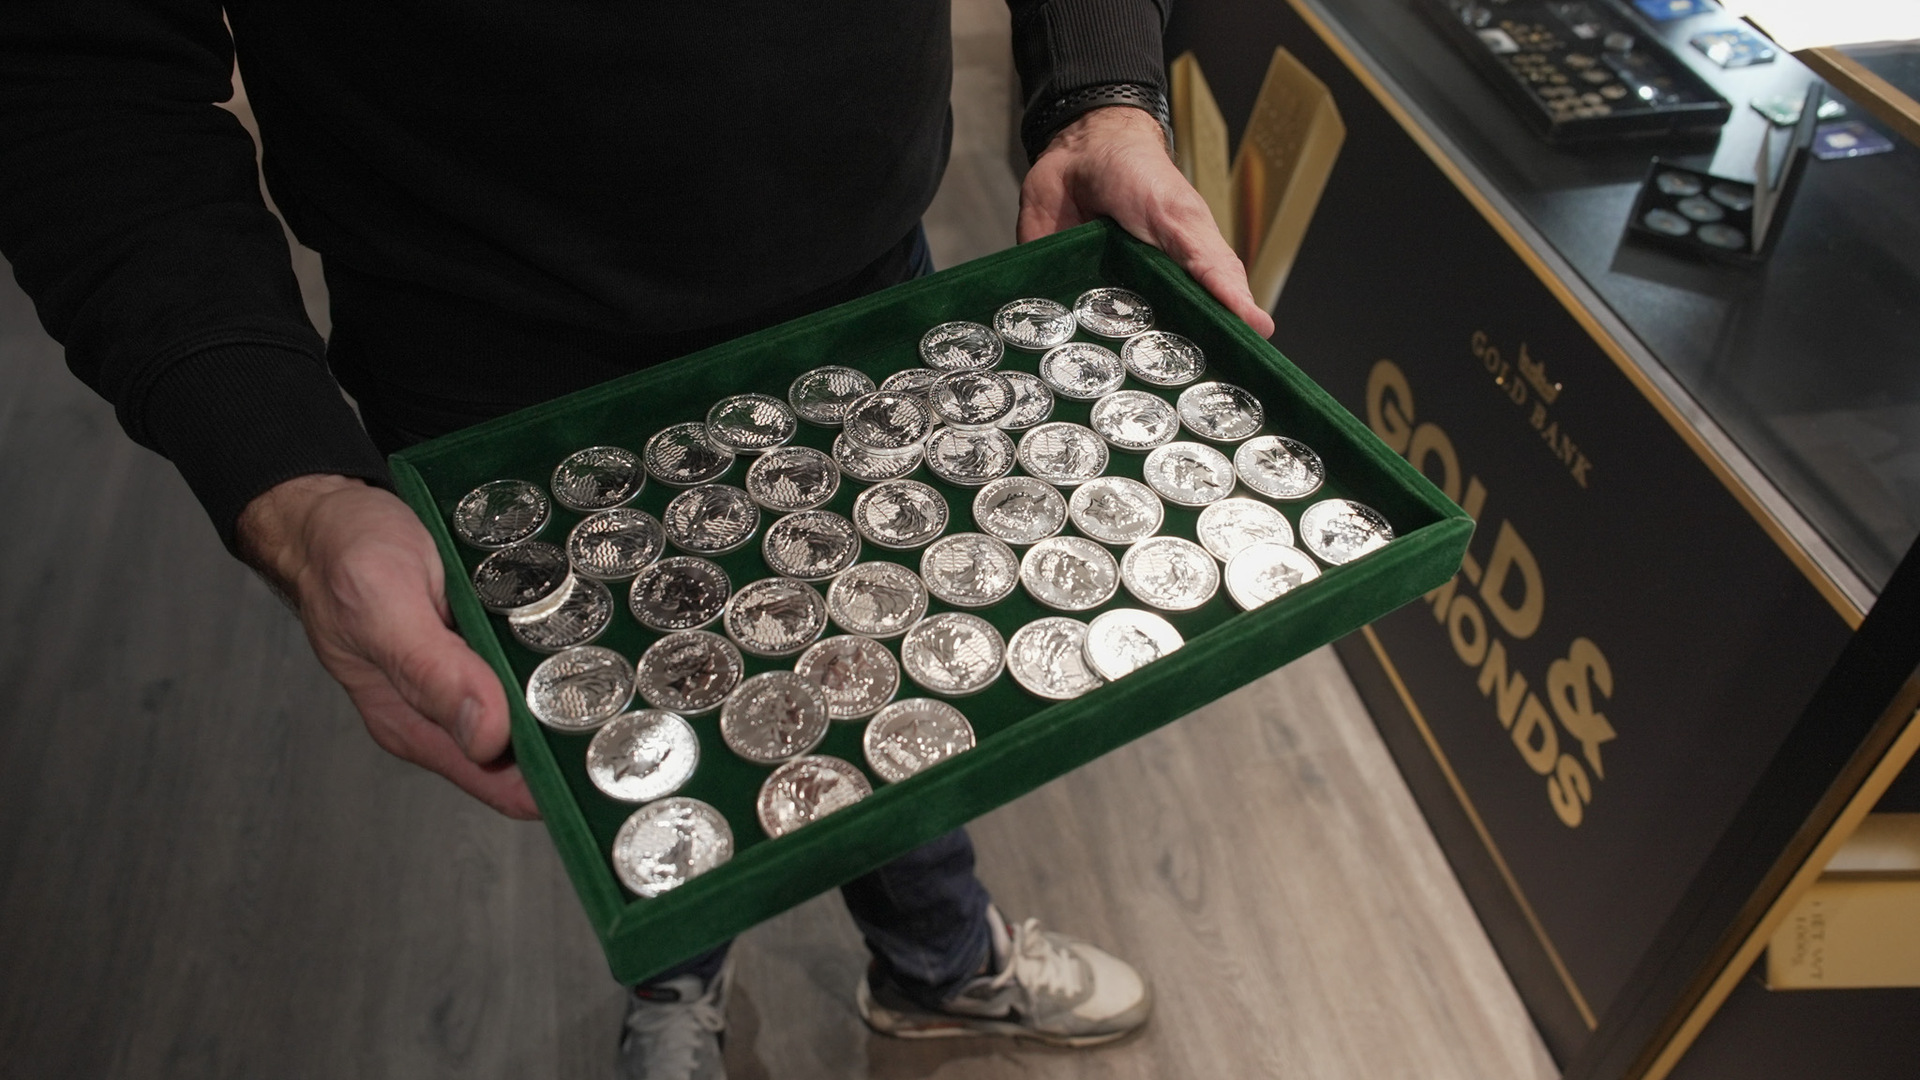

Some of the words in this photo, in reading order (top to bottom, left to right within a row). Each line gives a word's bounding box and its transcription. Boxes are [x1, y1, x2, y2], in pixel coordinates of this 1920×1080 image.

[1471, 330, 1527, 405] GOLD
[1530, 402, 1593, 488] BANK
[1366, 359, 1545, 639] GOLD
[1547, 637, 1617, 780] &
